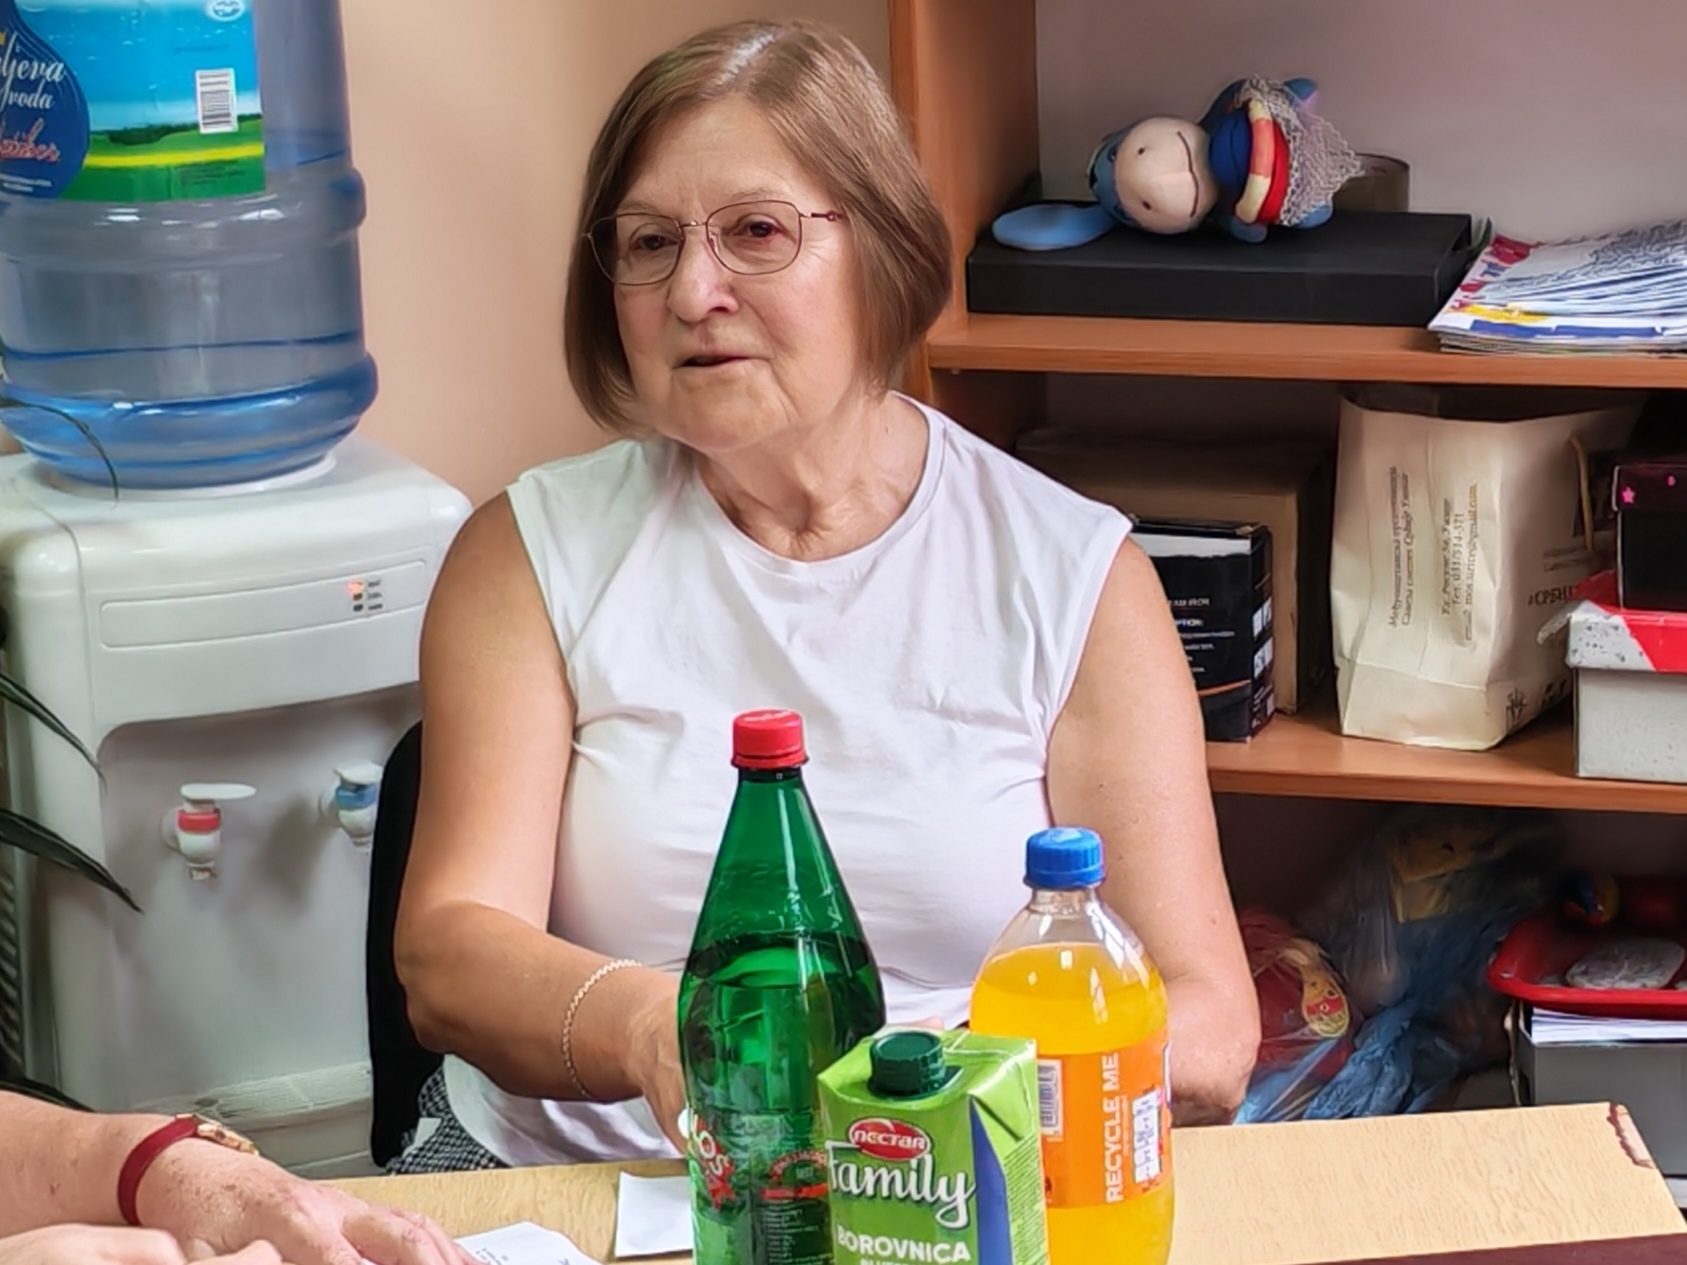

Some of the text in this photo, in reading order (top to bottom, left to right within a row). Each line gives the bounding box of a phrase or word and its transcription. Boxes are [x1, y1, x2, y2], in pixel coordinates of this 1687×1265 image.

[1101, 1052, 1124, 1203] RECYCLE ME
[824, 1139, 977, 1229] Family
[837, 1224, 971, 1265] BOROVNICA
